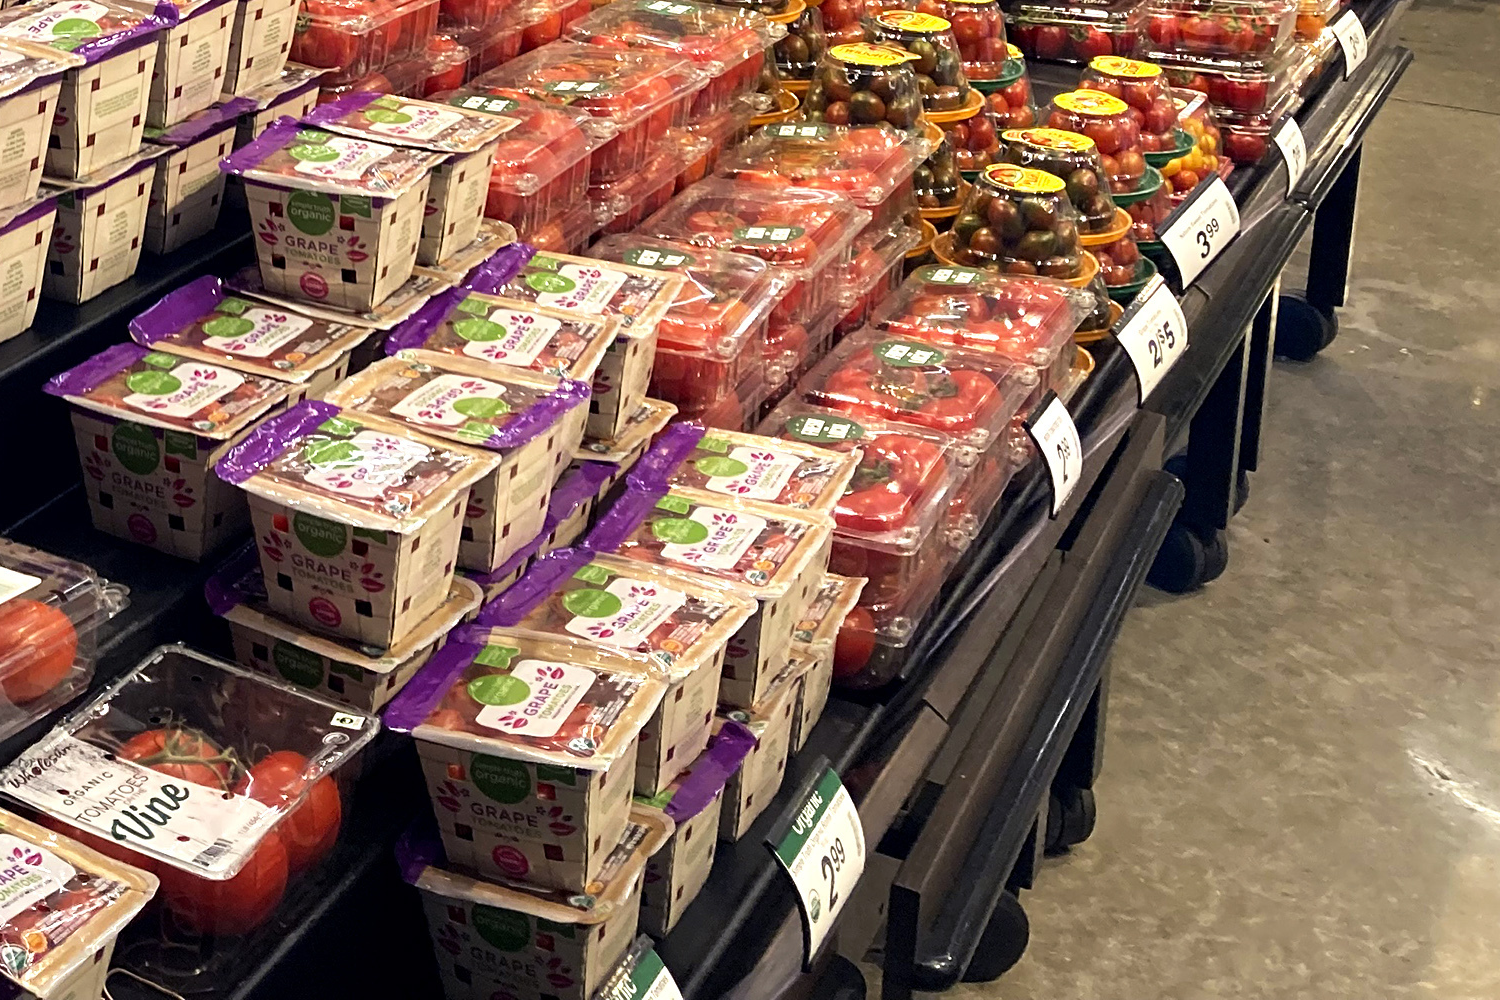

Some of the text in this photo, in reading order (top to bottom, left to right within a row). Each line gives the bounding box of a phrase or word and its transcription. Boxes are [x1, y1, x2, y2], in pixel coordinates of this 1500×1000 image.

[290, 206, 332, 223] organic
[284, 234, 339, 256] GRAPE
[284, 248, 342, 266] TOMATOES
[576, 277, 599, 301] GRAPE
[244, 319, 278, 346] GRAPE
[504, 323, 531, 353] GRAPE
[168, 377, 206, 405] GRAPE
[111, 472, 166, 499] GRAPE
[746, 459, 773, 487] GRAPE
[297, 522, 343, 544] organic
[703, 520, 735, 555] GRAPE
[291, 552, 352, 584] GRAPE
[291, 565, 354, 594] TOMATOES
[625, 601, 662, 634] TOMATOES
[523, 678, 560, 717] GRAPE
[538, 684, 573, 721] TOMATOES
[62, 770, 115, 807] ORGANIC
[474, 769, 528, 791] organic
[74, 772, 151, 824] TOMATOES
[110, 781, 190, 843] Vine
[470, 801, 539, 829] GRAPE
[470, 945, 537, 978] GRAPE
